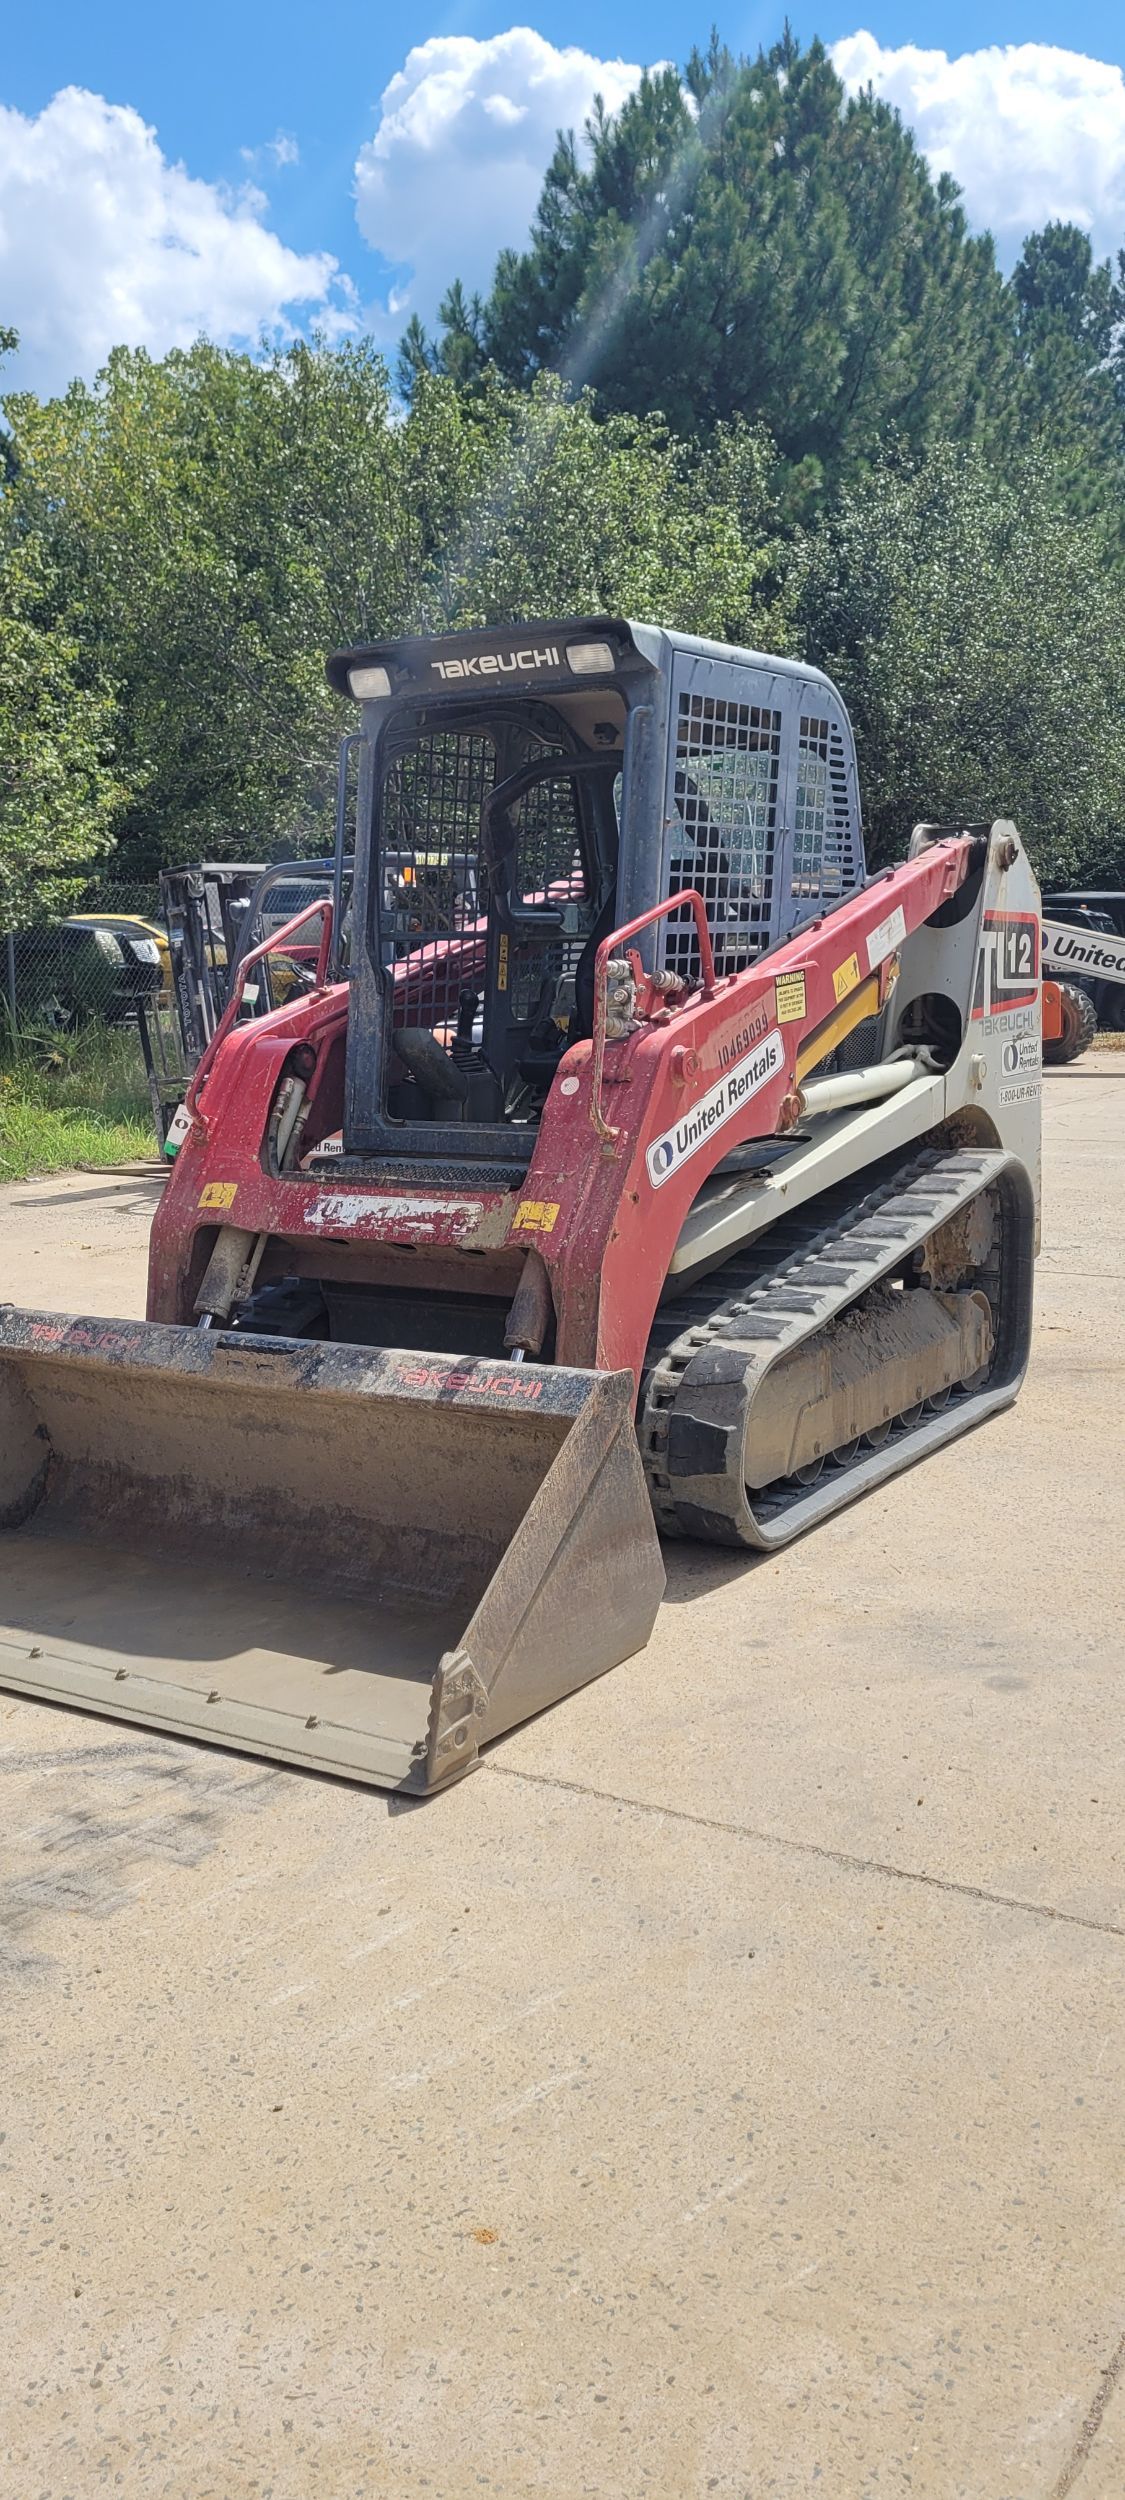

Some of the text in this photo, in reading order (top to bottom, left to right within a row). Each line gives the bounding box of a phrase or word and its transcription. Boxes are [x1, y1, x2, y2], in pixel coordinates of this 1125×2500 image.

[775, 971, 805, 986] WARNING
[178, 974, 192, 1026] TOYOTA
[1019, 1040, 1038, 1055] United
[1019, 1056, 1039, 1070] Rentals
[676, 1047, 777, 1154] United Rentals
